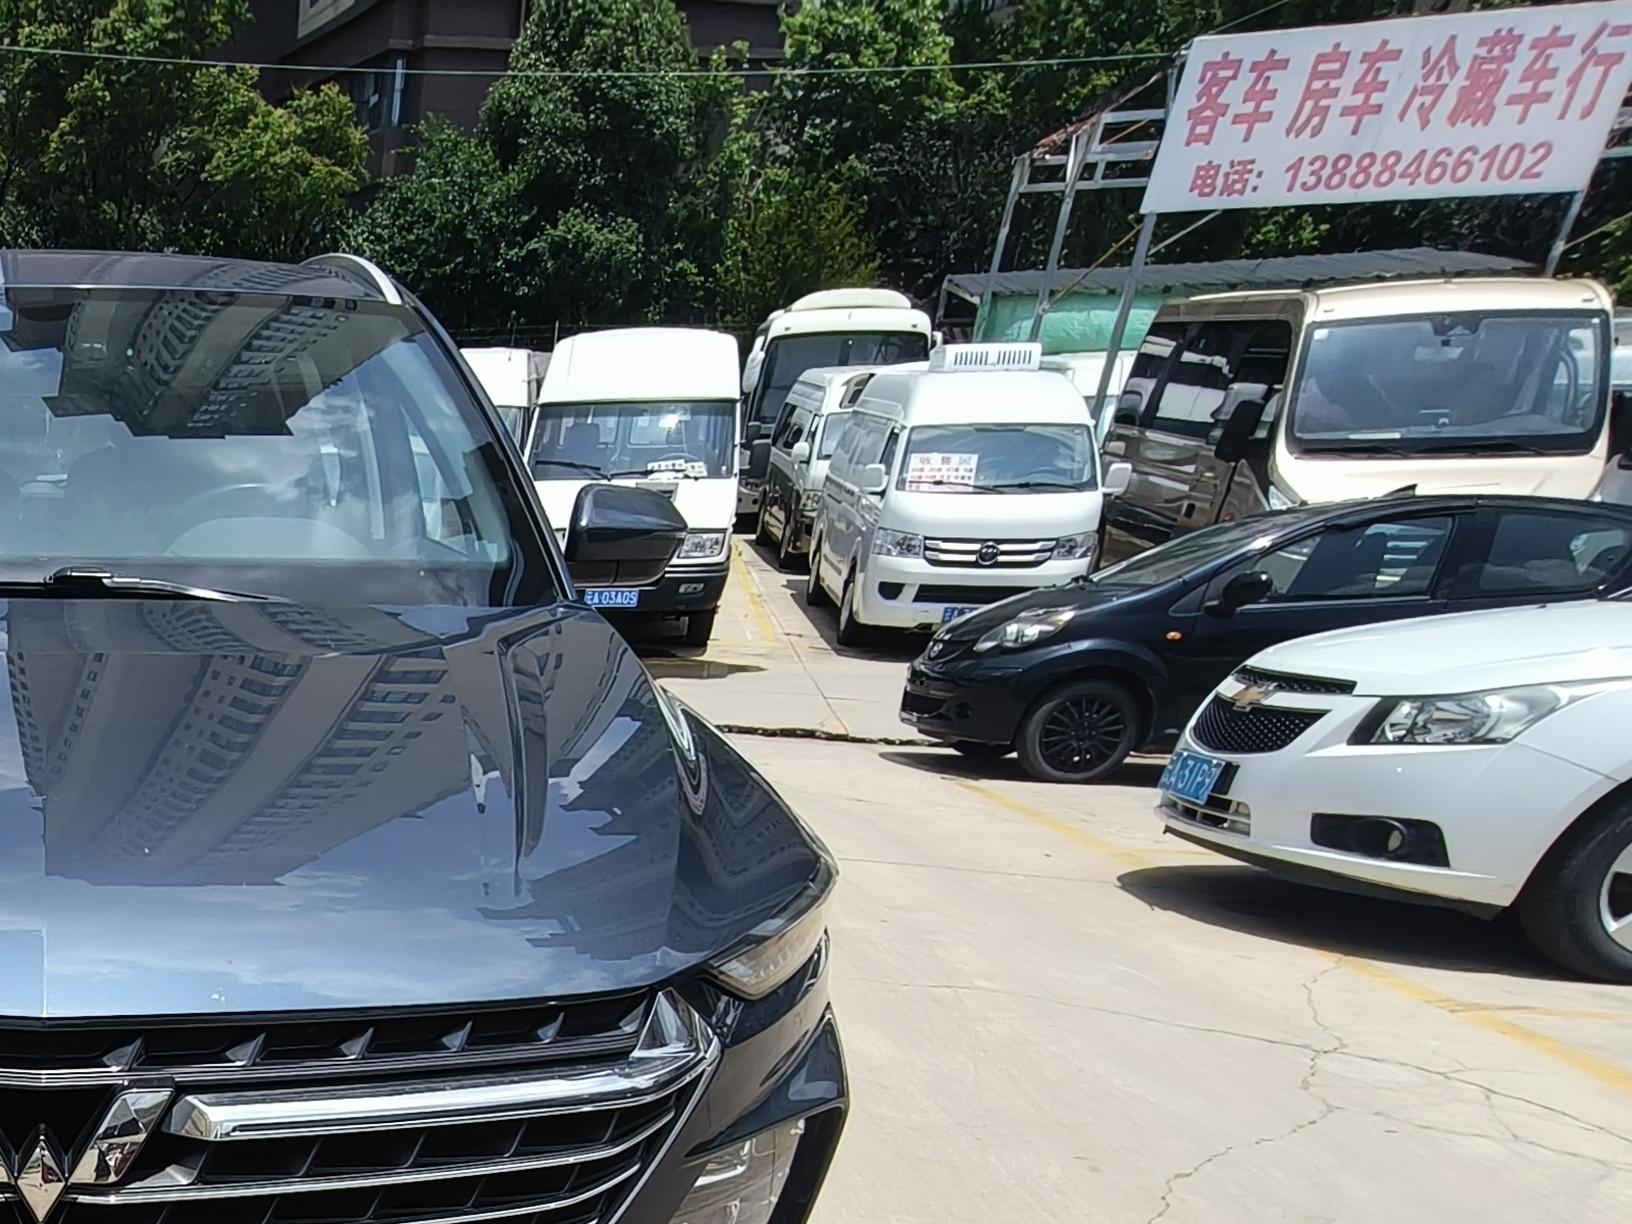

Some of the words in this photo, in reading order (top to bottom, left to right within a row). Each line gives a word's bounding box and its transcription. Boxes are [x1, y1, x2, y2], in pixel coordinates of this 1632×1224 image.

[1184, 49, 1289, 147] 客车
[1285, 38, 1402, 139] 房车
[1398, 20, 1632, 131] 冷藏车行
[1284, 140, 1554, 194] 13888466102
